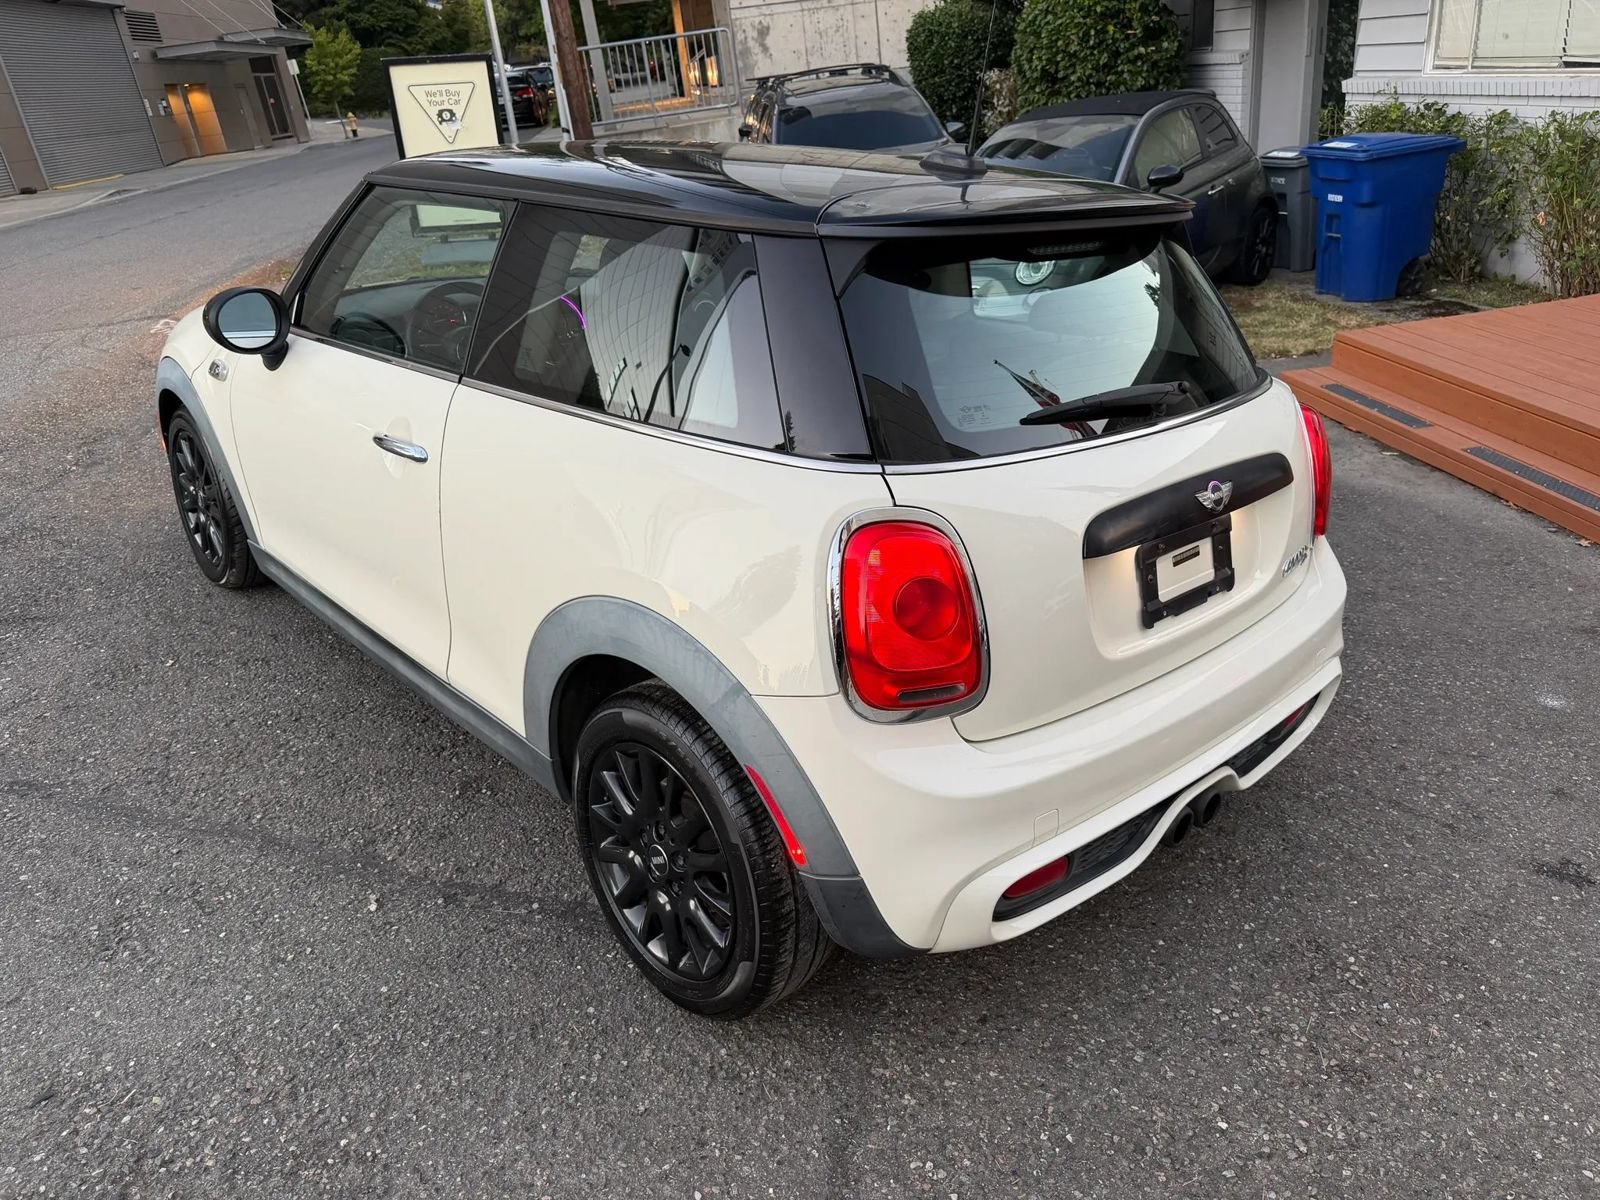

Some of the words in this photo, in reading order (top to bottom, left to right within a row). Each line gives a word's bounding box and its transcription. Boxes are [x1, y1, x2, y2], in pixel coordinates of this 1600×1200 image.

[425, 89, 444, 98] We'll
[444, 88, 461, 97] Buy
[427, 98, 445, 106] Your
[447, 97, 461, 105] Car
[651, 855, 665, 865] MINI
